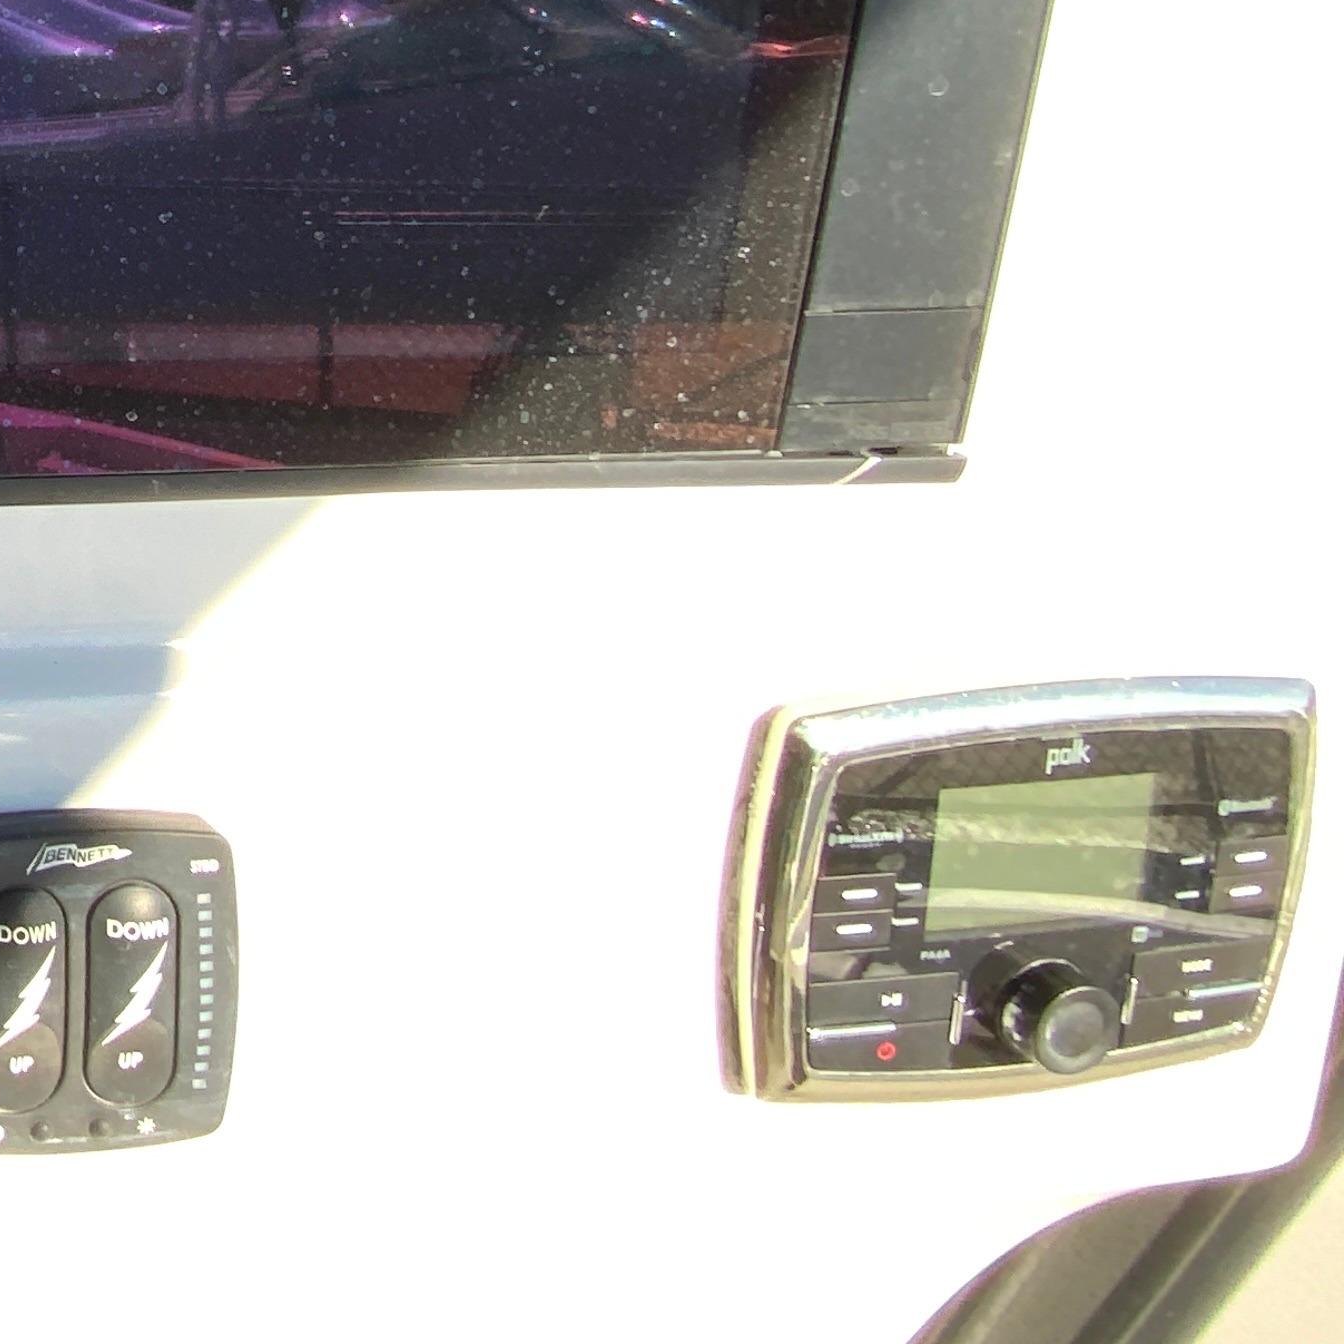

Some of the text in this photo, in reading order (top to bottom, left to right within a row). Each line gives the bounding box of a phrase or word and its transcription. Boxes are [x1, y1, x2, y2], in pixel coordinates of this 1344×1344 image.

[43, 845, 113, 865] BENNETT
[107, 918, 169, 940] DOWN
[9, 1056, 34, 1074] UP
[118, 1052, 143, 1069] UP
